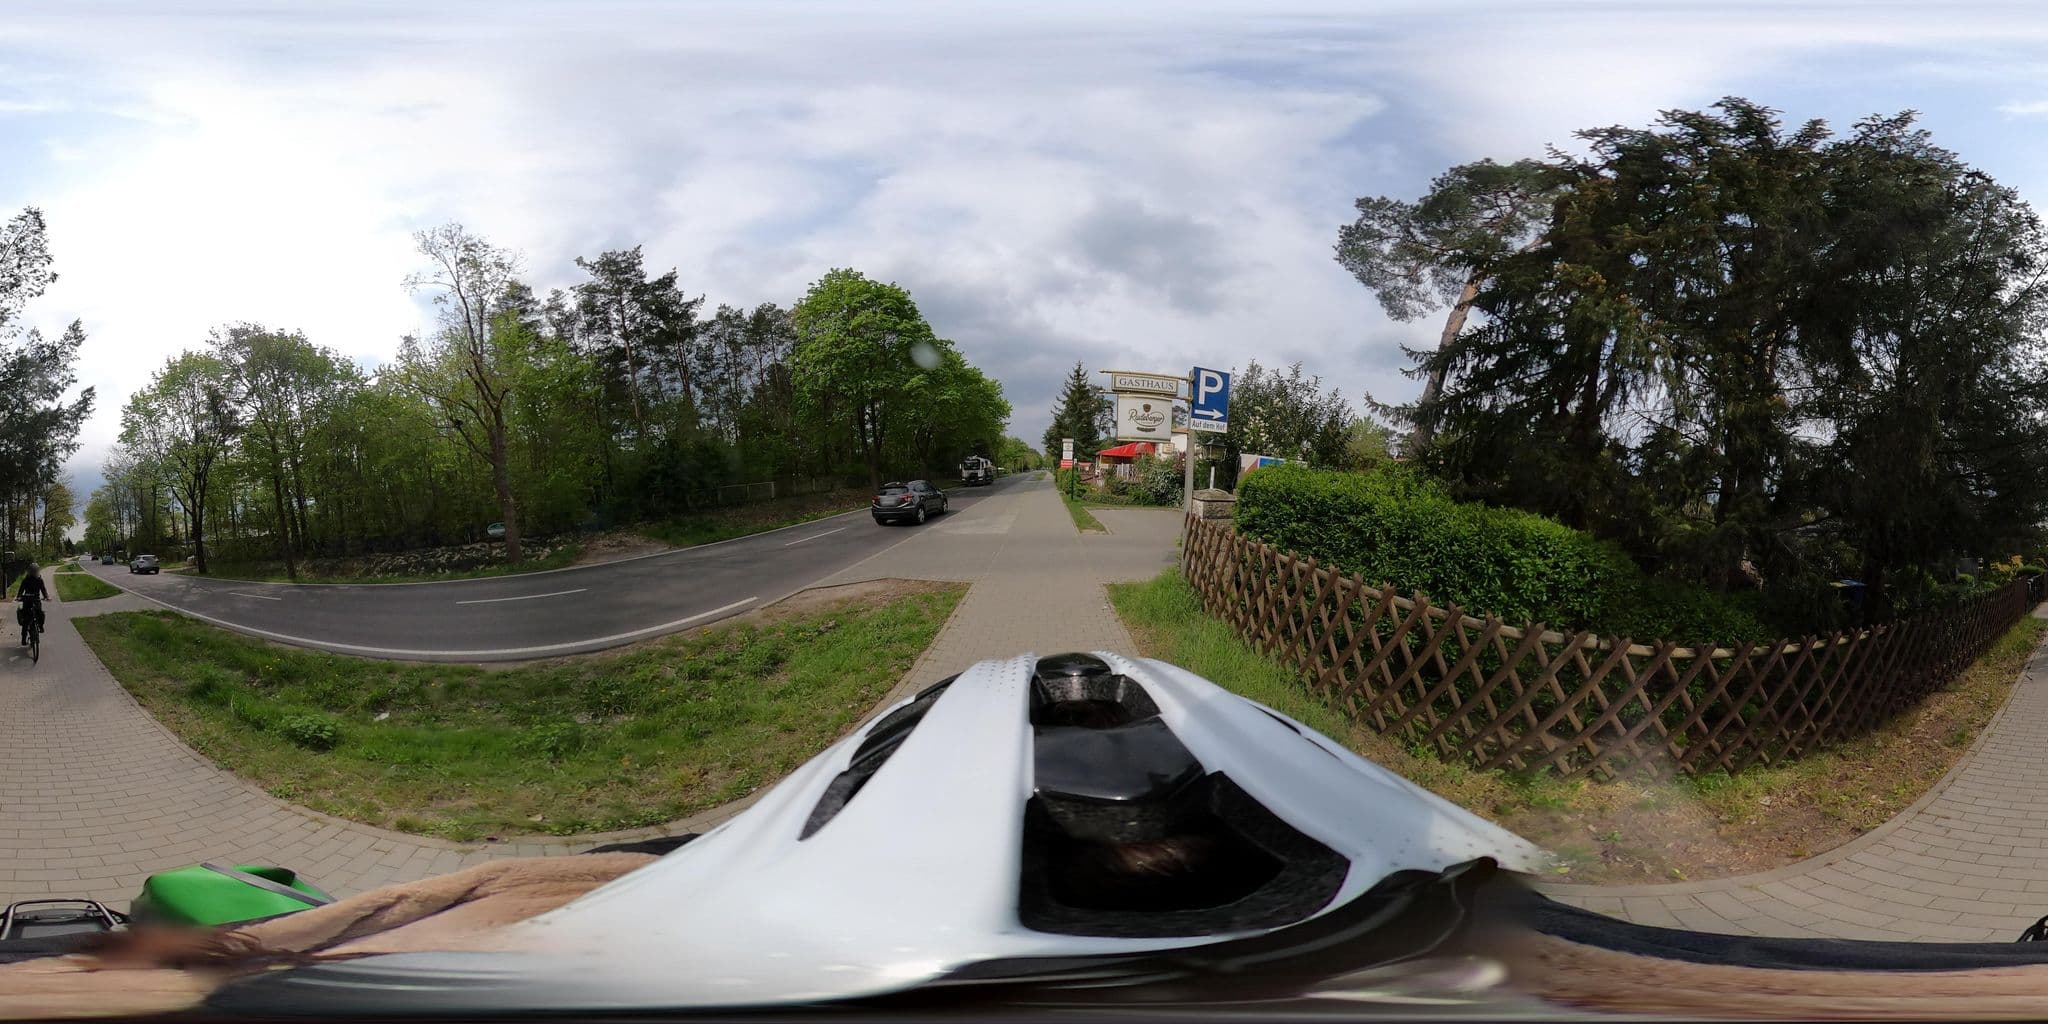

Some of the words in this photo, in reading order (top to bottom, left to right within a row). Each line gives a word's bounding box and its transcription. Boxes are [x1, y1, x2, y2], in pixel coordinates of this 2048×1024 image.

[1119, 378, 1174, 391] GASTHAUS
[1199, 370, 1223, 405] P
[1203, 421, 1216, 429] dem
[1216, 423, 1226, 431] Hof
